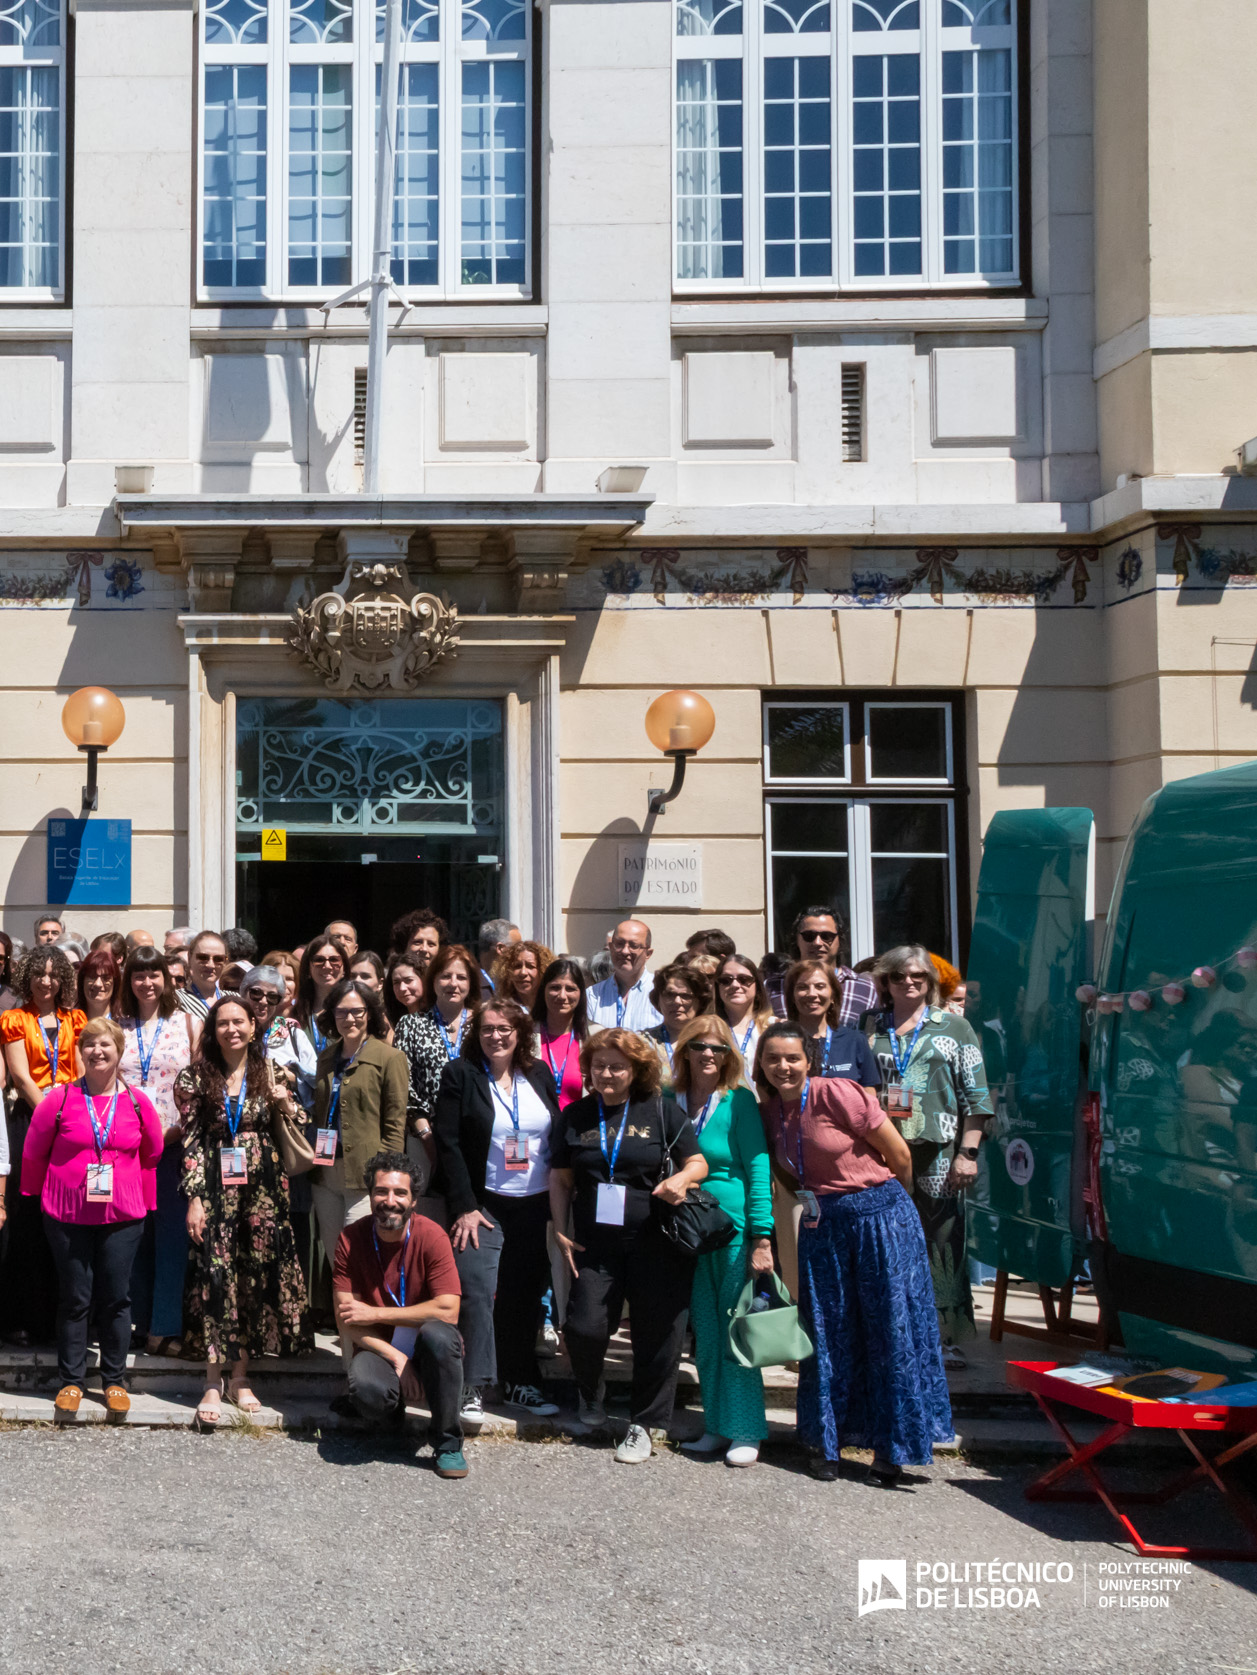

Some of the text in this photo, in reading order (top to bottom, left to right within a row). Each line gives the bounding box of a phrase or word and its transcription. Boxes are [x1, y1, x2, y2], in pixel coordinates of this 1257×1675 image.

[53, 847, 126, 869] ESELx
[624, 880, 697, 894] DO ESTADO
